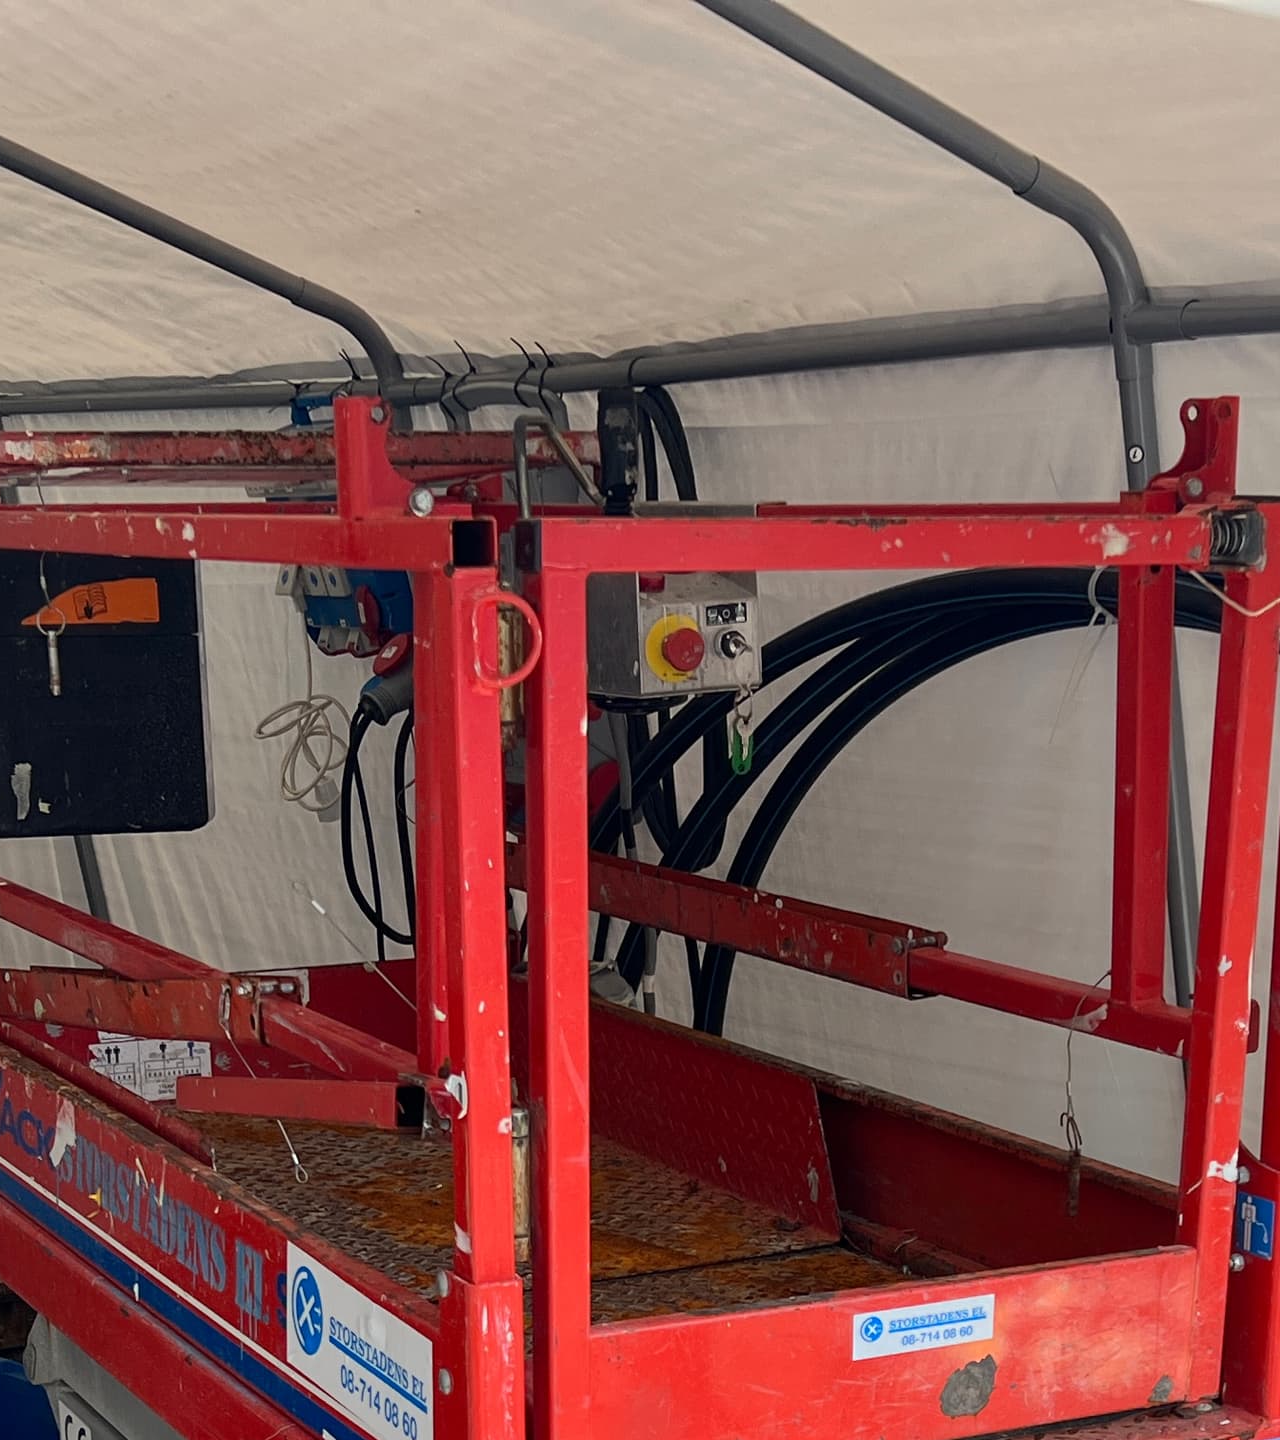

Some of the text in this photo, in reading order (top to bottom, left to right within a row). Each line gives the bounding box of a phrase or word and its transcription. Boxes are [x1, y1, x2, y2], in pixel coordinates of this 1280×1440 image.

[889, 1306, 986, 1330] STORSTADENS EL
[901, 1325, 974, 1346] 08-714 08 60
[329, 1316, 427, 1402] STORSTADENS EL
[340, 1364, 381, 1415] 08-714
[384, 1397, 399, 1428] 08
